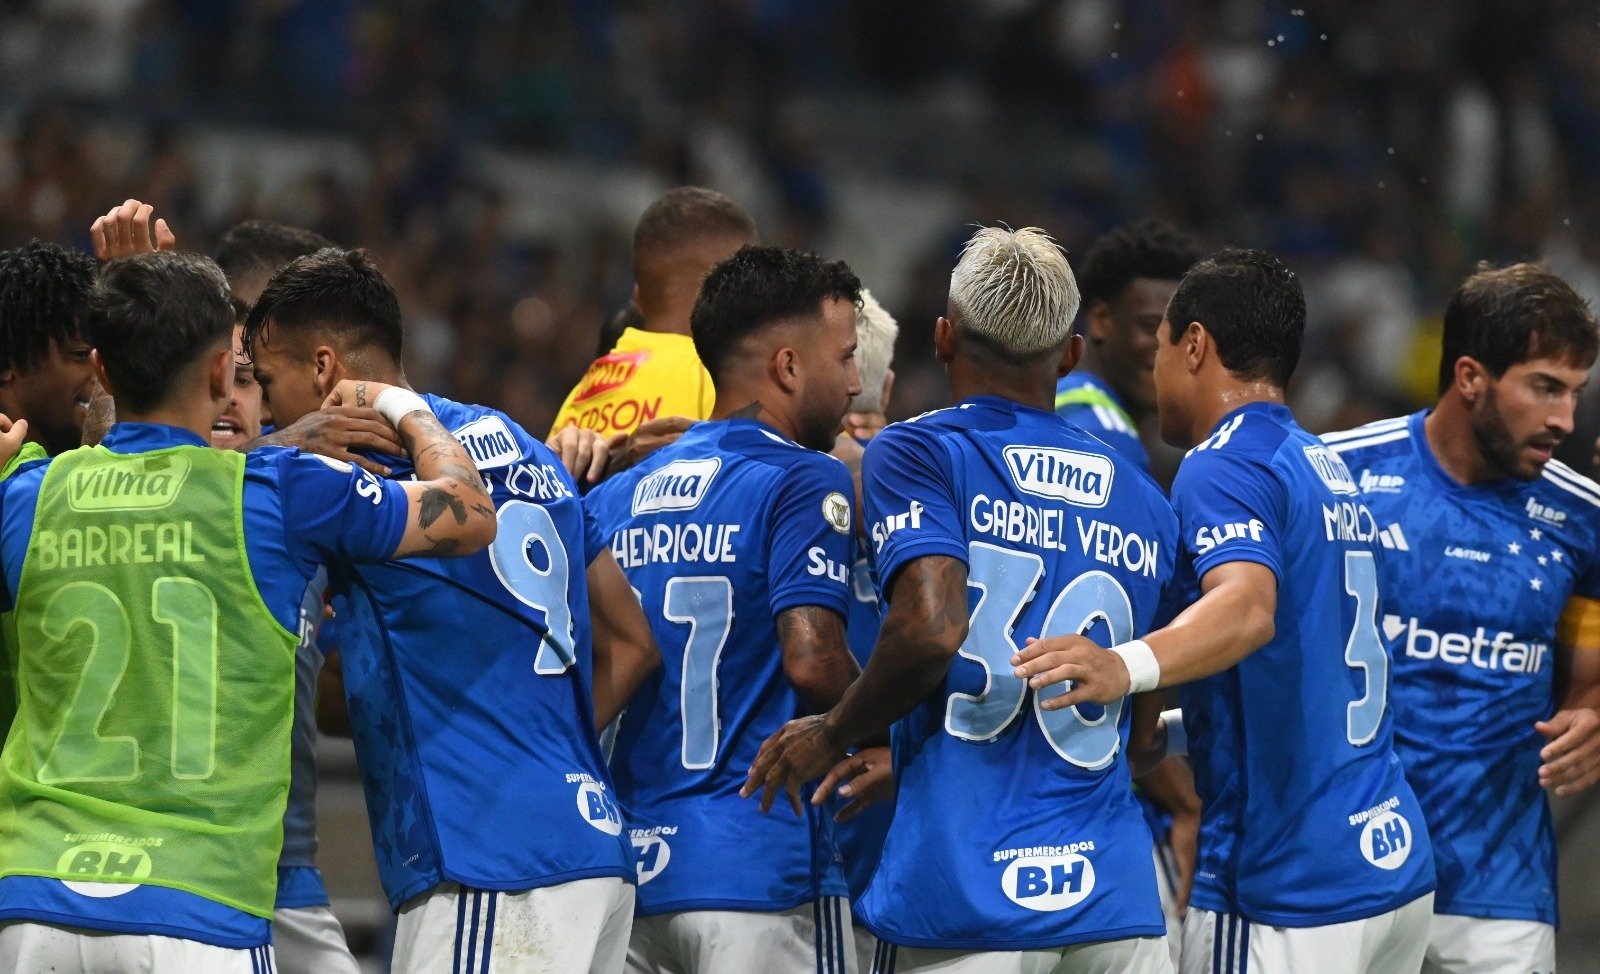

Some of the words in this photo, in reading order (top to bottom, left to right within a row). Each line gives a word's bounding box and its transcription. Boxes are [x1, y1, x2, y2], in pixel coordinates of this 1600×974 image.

[458, 430, 513, 462] ilma
[72, 465, 172, 500] Vilma
[637, 470, 703, 508] Vilma
[1011, 452, 1102, 496] Vilma
[970, 494, 1066, 552] GABRIEL
[1076, 515, 1158, 579] VERON
[1195, 518, 1264, 555] Surf
[1322, 502, 1379, 543] MRLO
[38, 521, 206, 571] BARREAL
[612, 523, 740, 568] HENRIQUE
[944, 540, 1134, 771] 30
[1404, 617, 1549, 674] betfair
[37, 576, 218, 784] 21
[993, 840, 1095, 862] SUPERMERCADOS
[1372, 817, 1406, 861] BH
[68, 850, 143, 878] BH
[1016, 860, 1085, 899] BH
